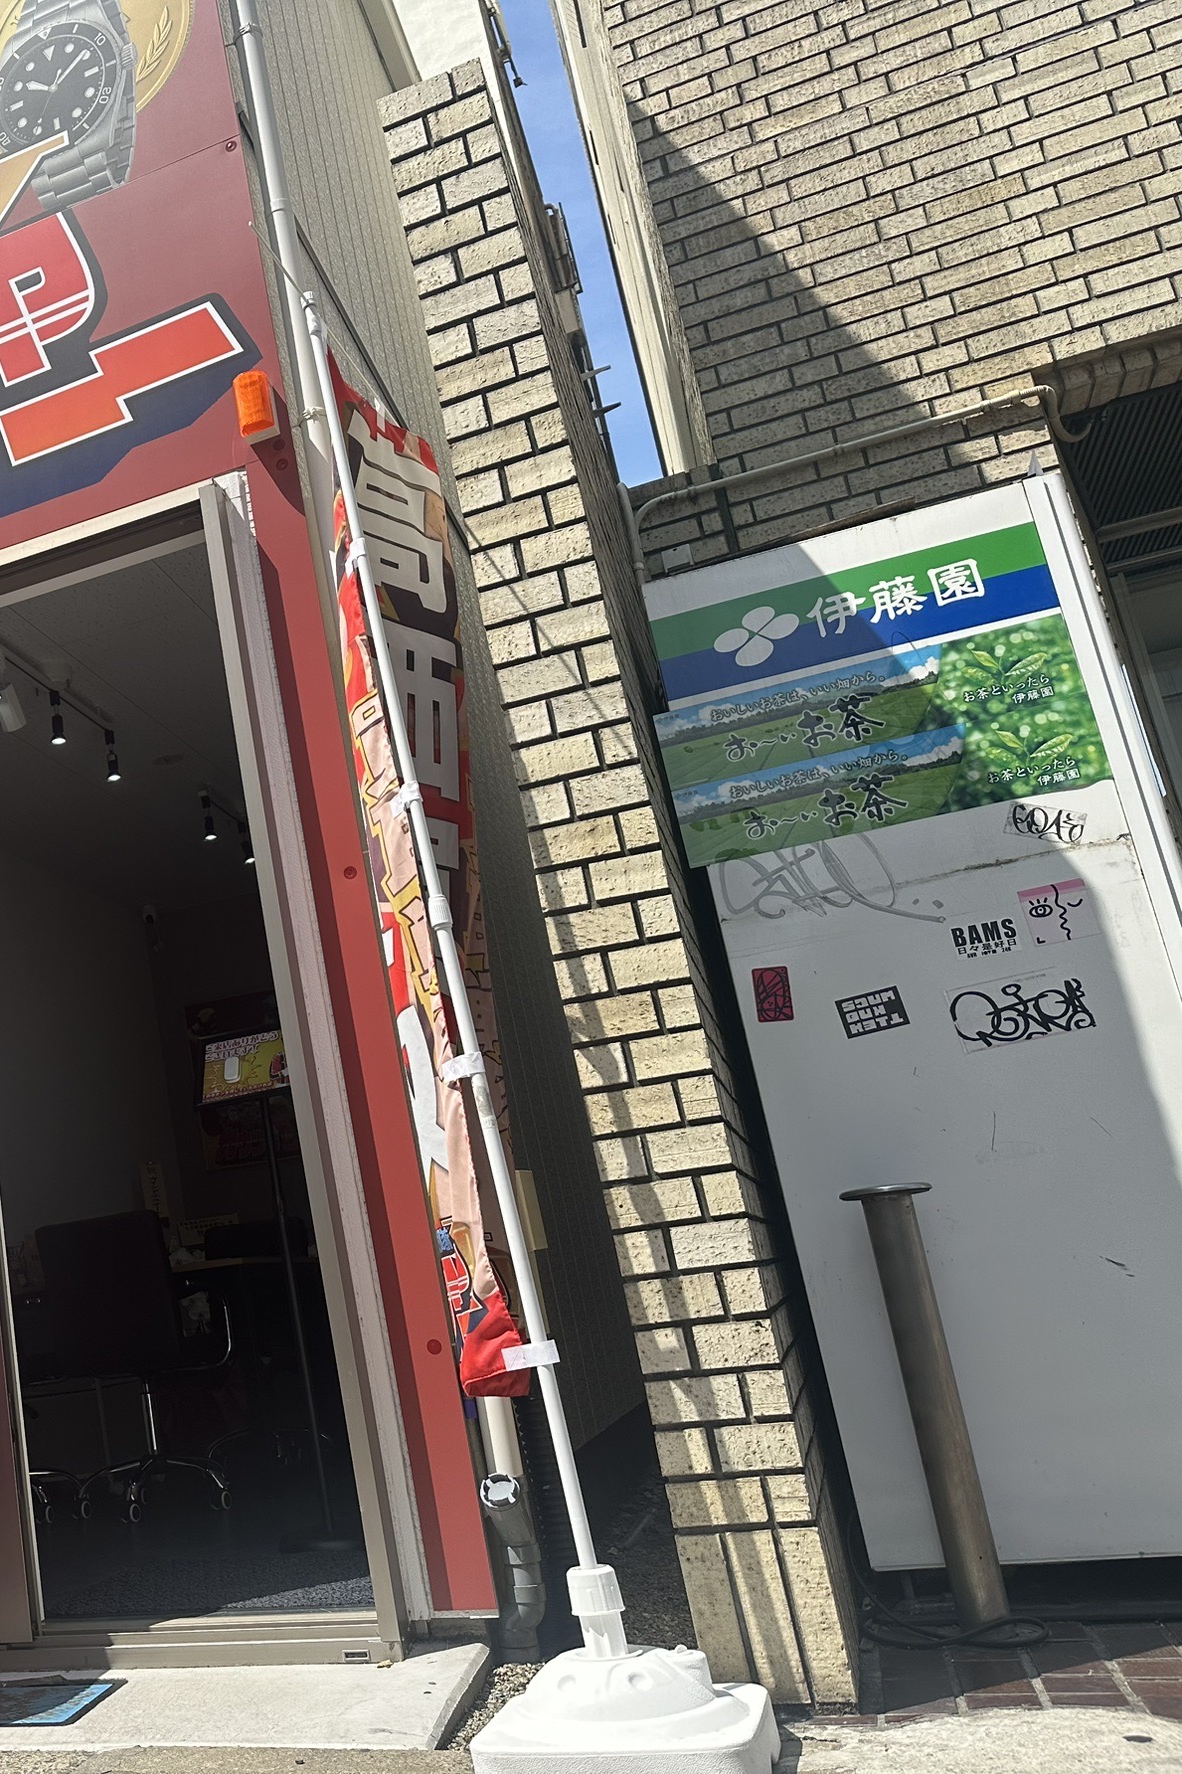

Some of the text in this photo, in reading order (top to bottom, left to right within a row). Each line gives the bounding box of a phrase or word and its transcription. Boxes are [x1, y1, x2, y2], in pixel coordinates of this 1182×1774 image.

[806, 557, 985, 638] 伊藤園
[711, 670, 885, 722] おいしいお茶は、いい畑から。
[963, 674, 1050, 702] お茶といったら
[1012, 685, 1054, 704] 伊藤園
[730, 749, 908, 798] おいしいお茶は、いい畑から。
[988, 756, 1076, 784] お茶といったら
[1037, 768, 1080, 786] 伊藤園
[950, 918, 1017, 948] BAMS
[958, 939, 1017, 955] 日々是好日
